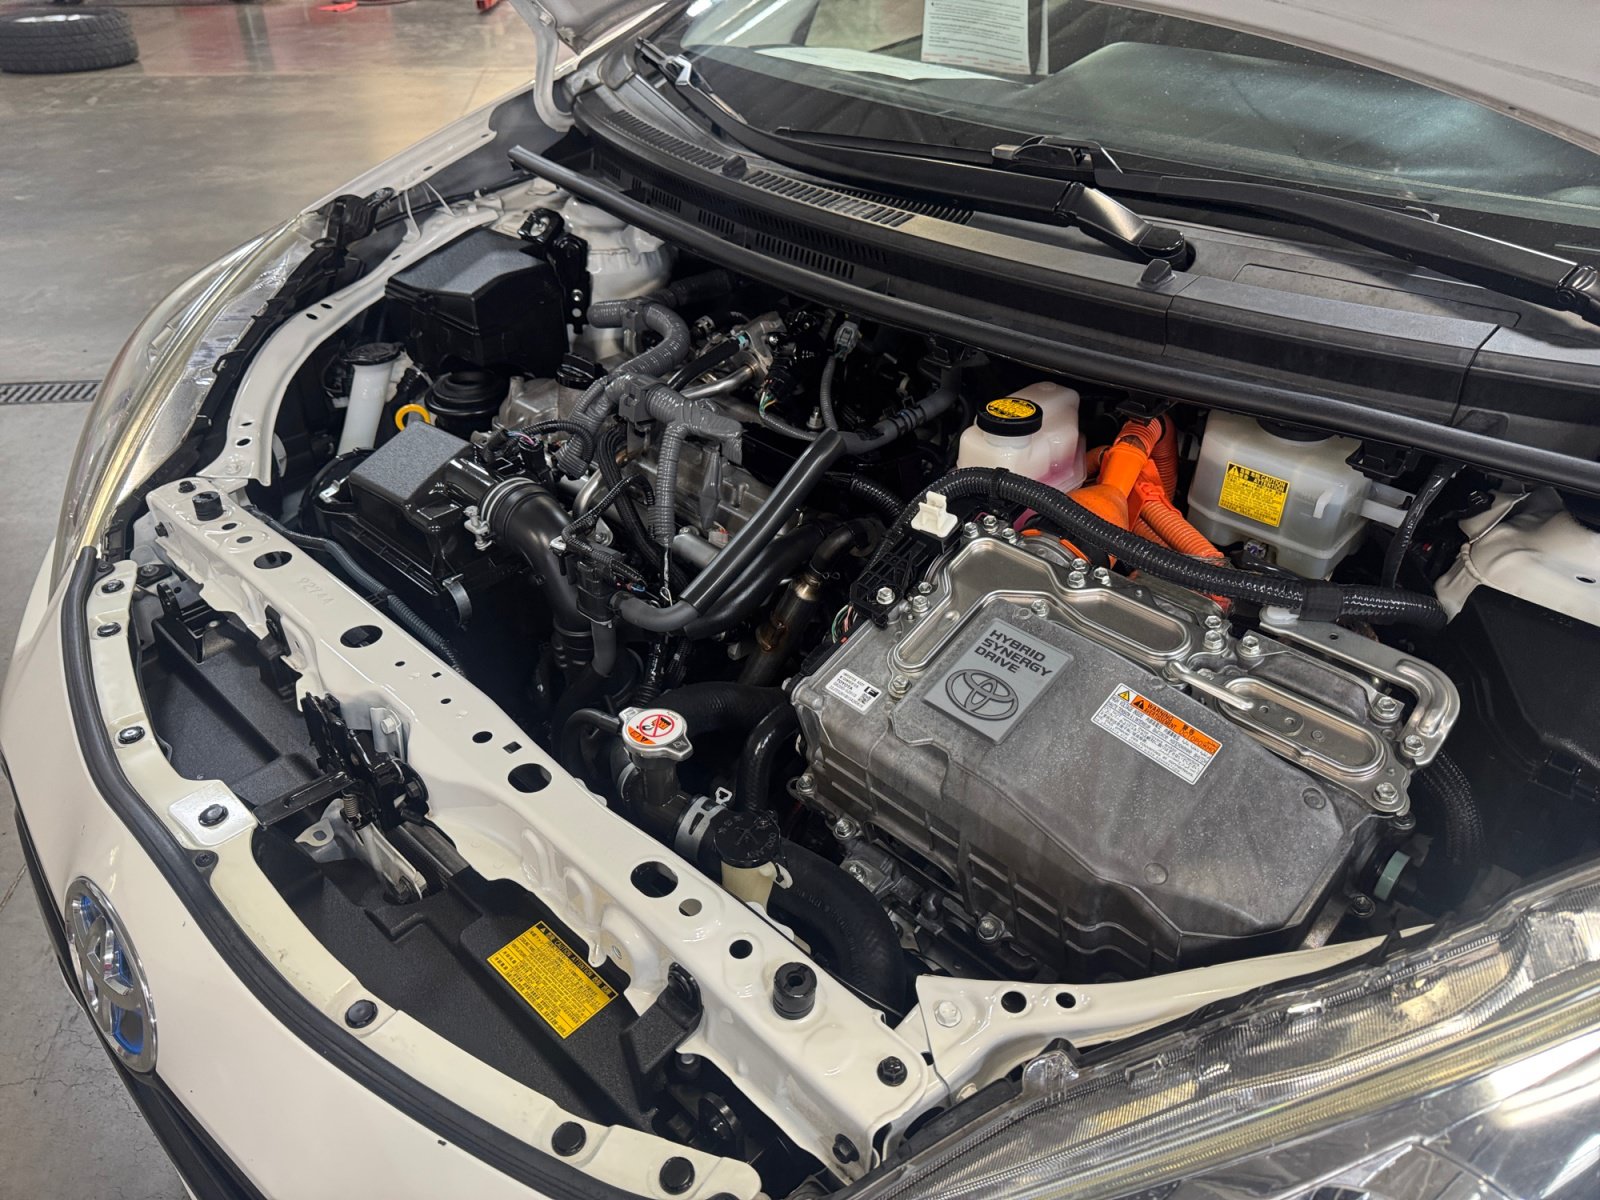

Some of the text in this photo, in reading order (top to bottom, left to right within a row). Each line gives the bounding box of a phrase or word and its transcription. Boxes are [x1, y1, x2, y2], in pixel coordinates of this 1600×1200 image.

[1253, 477, 1285, 492] ATTENTION
[1260, 475, 1286, 488] CAUTION
[981, 637, 1053, 677] SYNERGY
[989, 629, 1046, 663] HYBRID
[974, 646, 1021, 674] DRIVE
[836, 678, 854, 690] TOYOTA
[1146, 702, 1174, 722] WARNING
[554, 940, 592, 977] CAUTION ATTENTION
